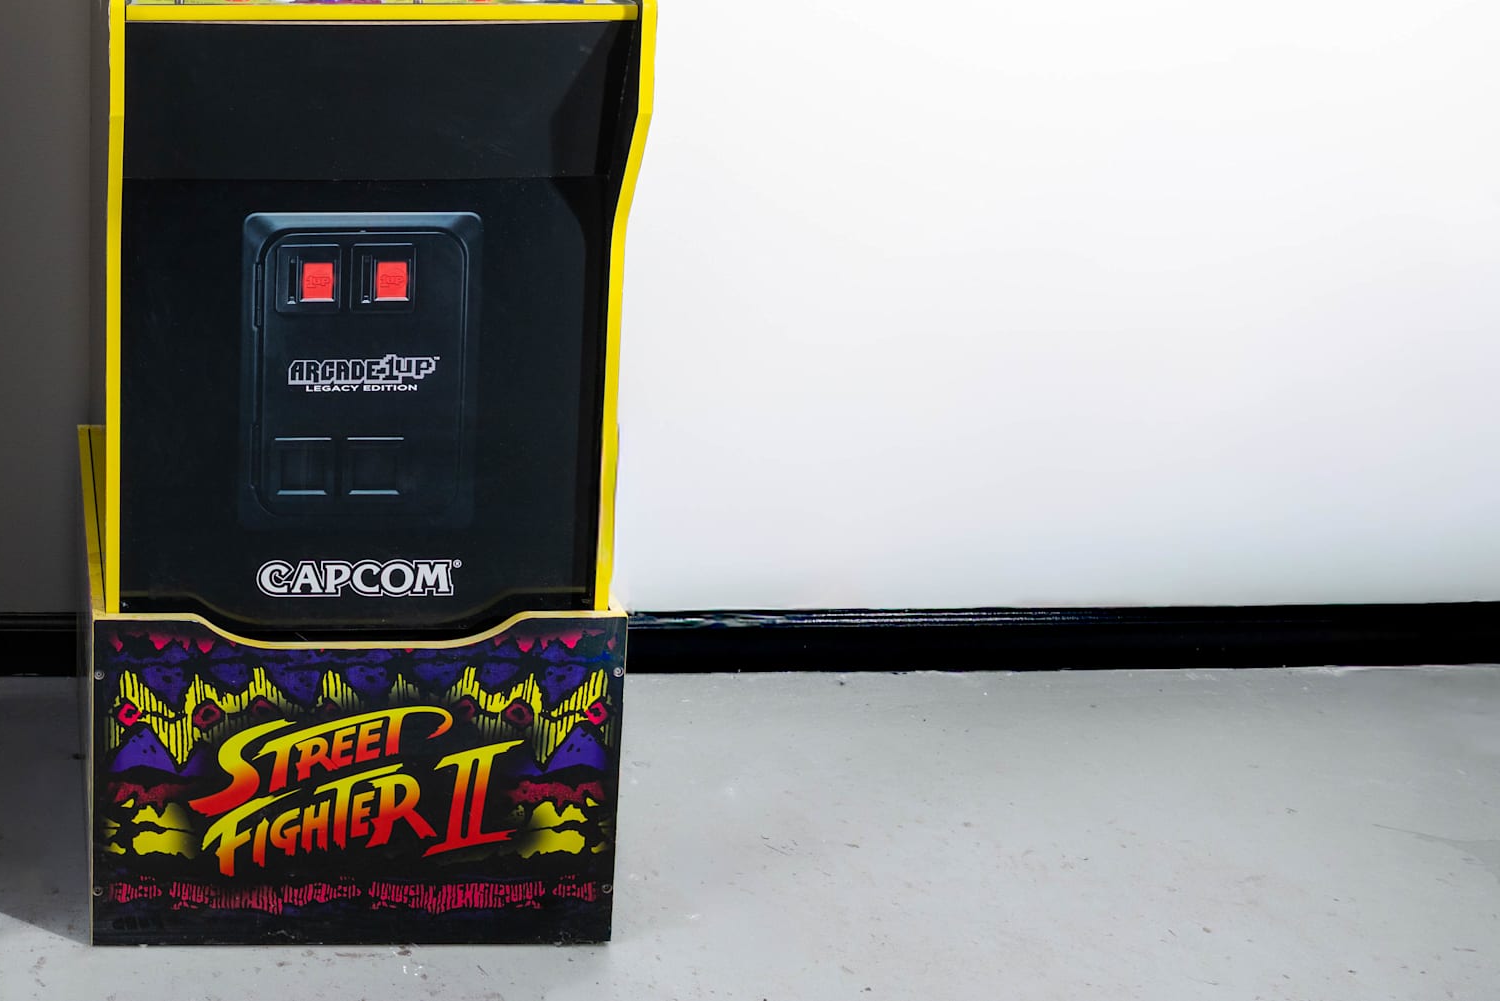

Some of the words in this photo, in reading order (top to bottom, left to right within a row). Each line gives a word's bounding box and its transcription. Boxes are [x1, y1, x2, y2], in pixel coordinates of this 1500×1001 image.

[305, 384, 359, 392] LEGACY
[363, 384, 418, 392] EDITION
[188, 706, 453, 817] STREET
[201, 763, 437, 877] FIGHTER
[422, 740, 525, 858] II
